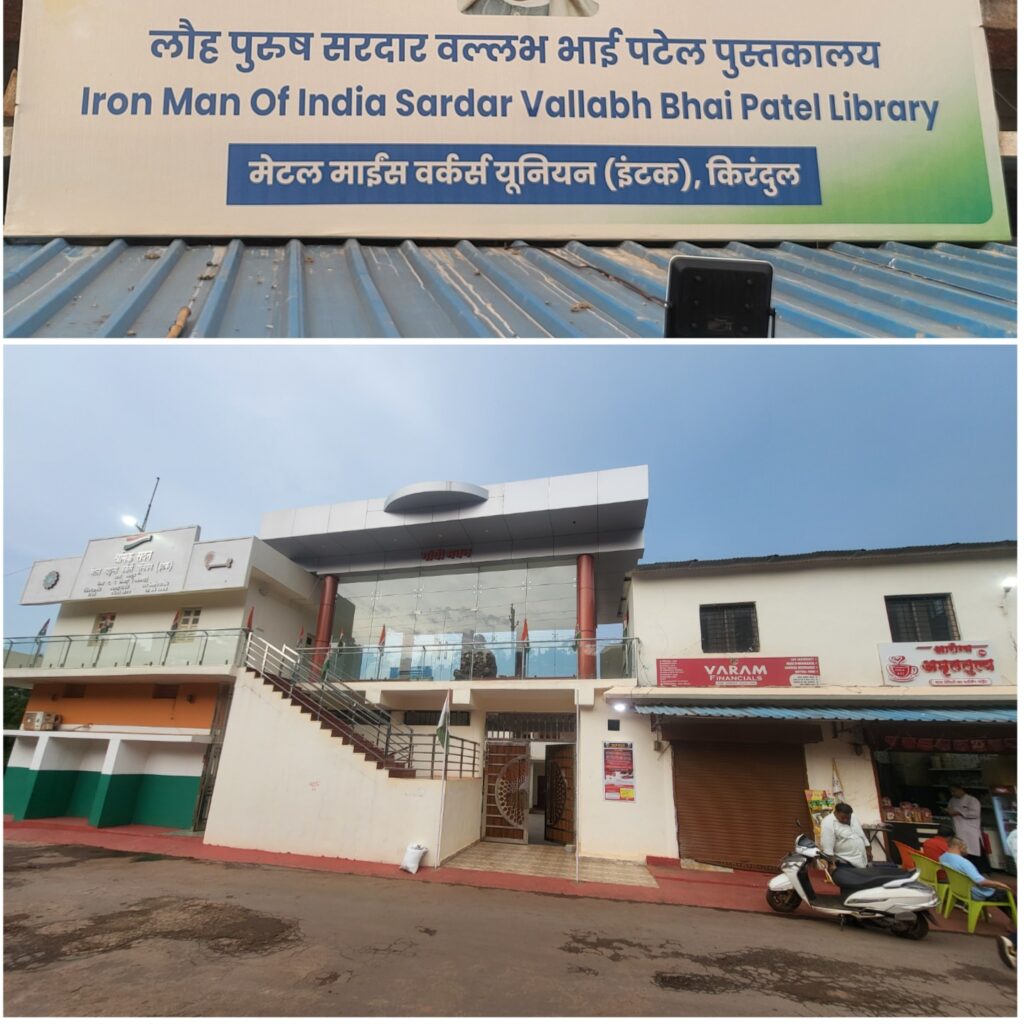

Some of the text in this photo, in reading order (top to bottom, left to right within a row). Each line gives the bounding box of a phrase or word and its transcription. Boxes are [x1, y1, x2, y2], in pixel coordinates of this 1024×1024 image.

[149, 18, 880, 79] लौह पुरुष सरदार वल्लभ भाई पटेल पुस्तकालय
[81, 86, 939, 131] Iron Man Of India Sardar Vallabh Bhai Patel Library
[248, 154, 325, 185] मेटल
[413, 153, 493, 185] वर्कर्स
[493, 153, 597, 195] यूनियन
[604, 155, 701, 192] (इंटक),
[706, 154, 800, 197] किरंदुल
[704, 665, 768, 675] VARAM
